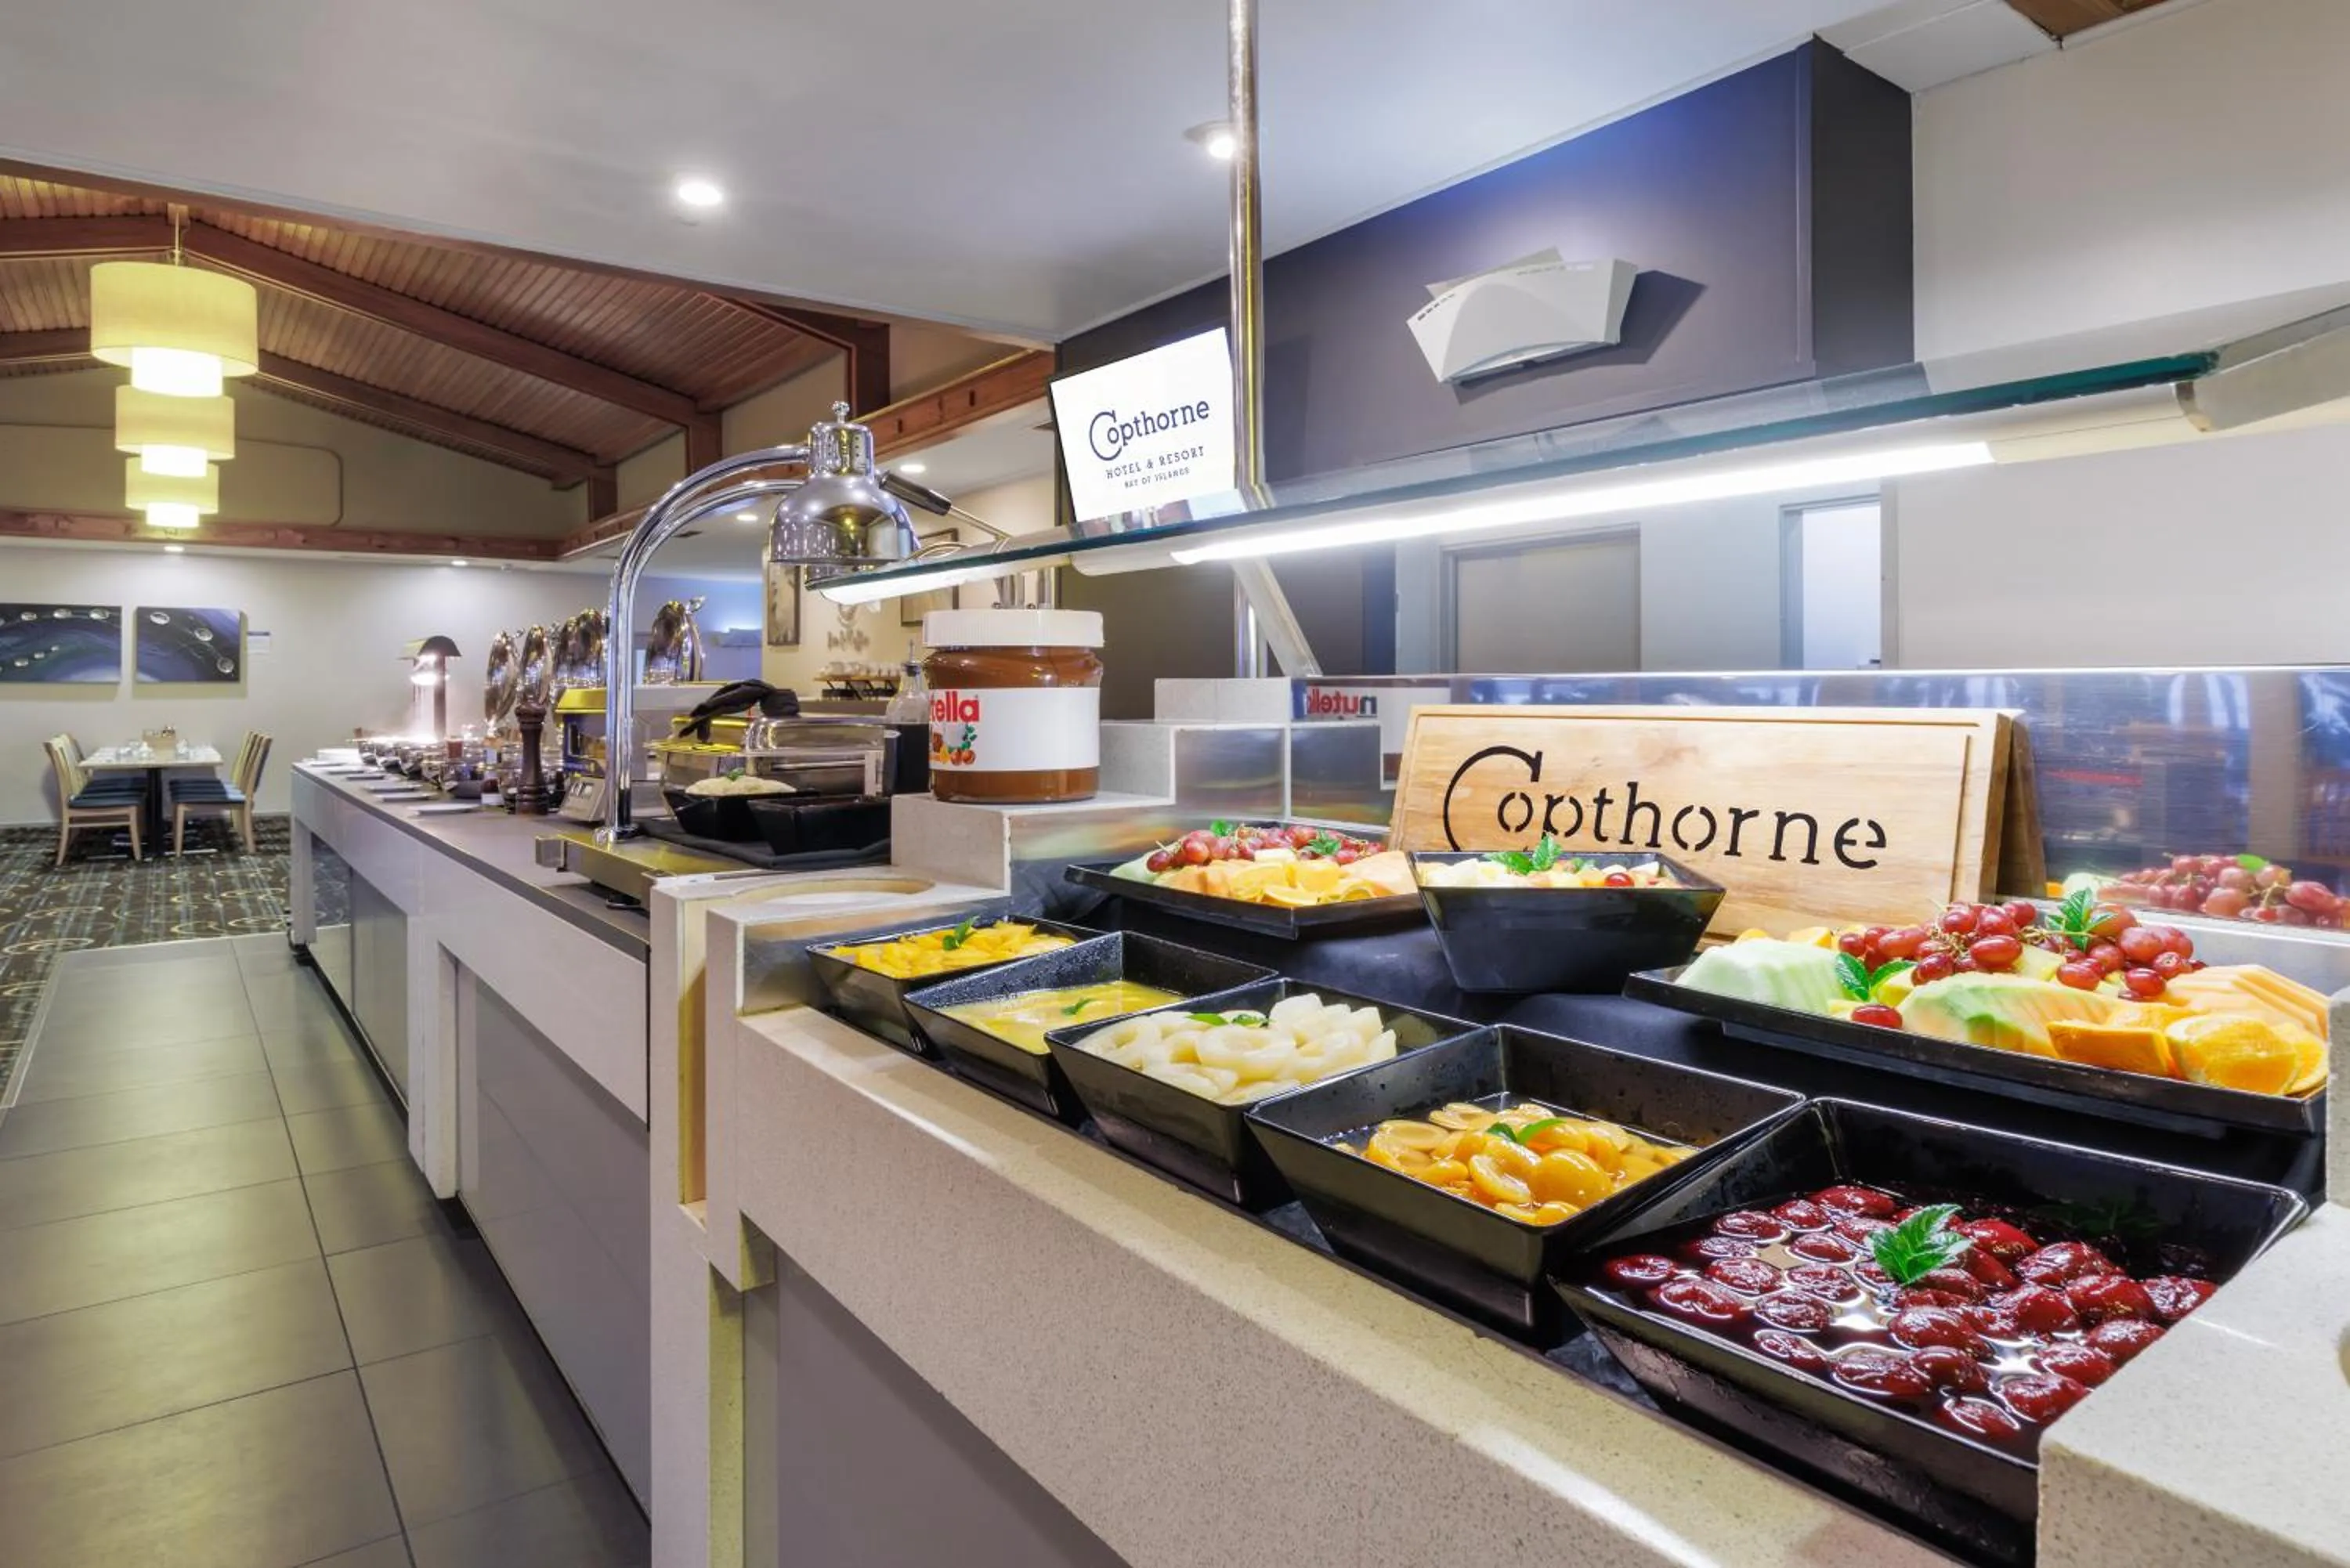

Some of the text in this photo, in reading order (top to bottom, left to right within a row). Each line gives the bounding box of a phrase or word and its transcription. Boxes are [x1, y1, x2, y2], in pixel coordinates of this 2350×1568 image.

[1089, 401, 1209, 461] Copthorne
[1105, 446, 1204, 479] HOTEL & RESORT
